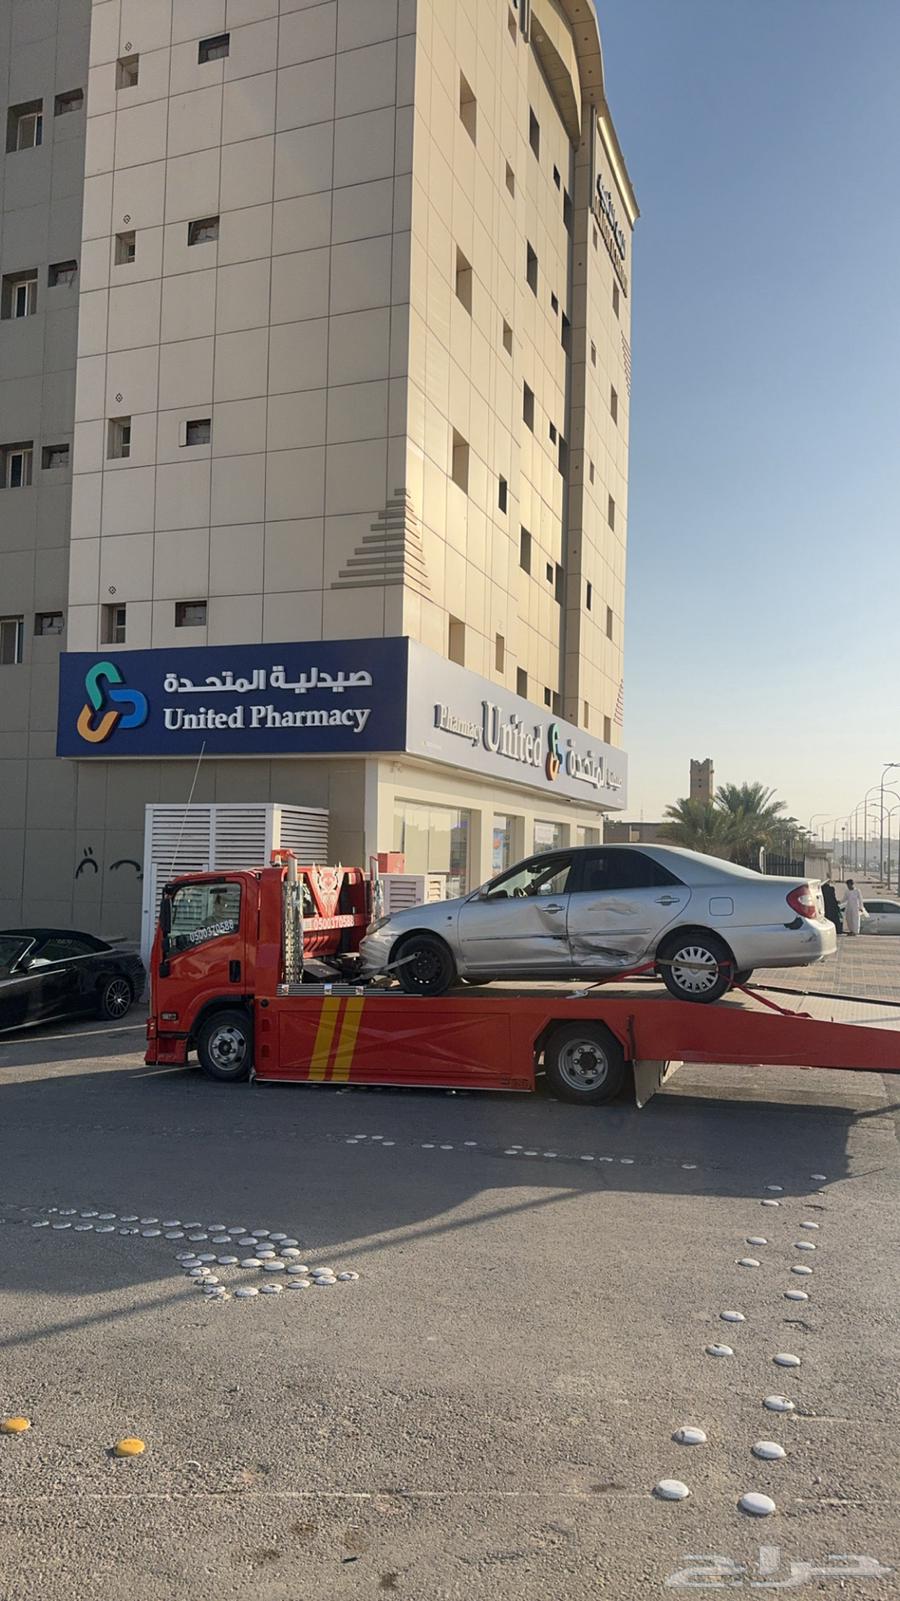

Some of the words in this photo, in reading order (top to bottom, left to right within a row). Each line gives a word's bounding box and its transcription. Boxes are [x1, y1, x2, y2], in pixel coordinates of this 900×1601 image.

[164, 669, 266, 693] المتحدة
[270, 665, 373, 694] صيدلية
[163, 705, 245, 730] United
[249, 704, 371, 733] Pharmacy
[433, 702, 483, 748] Pharmacy
[481, 700, 543, 768] United
